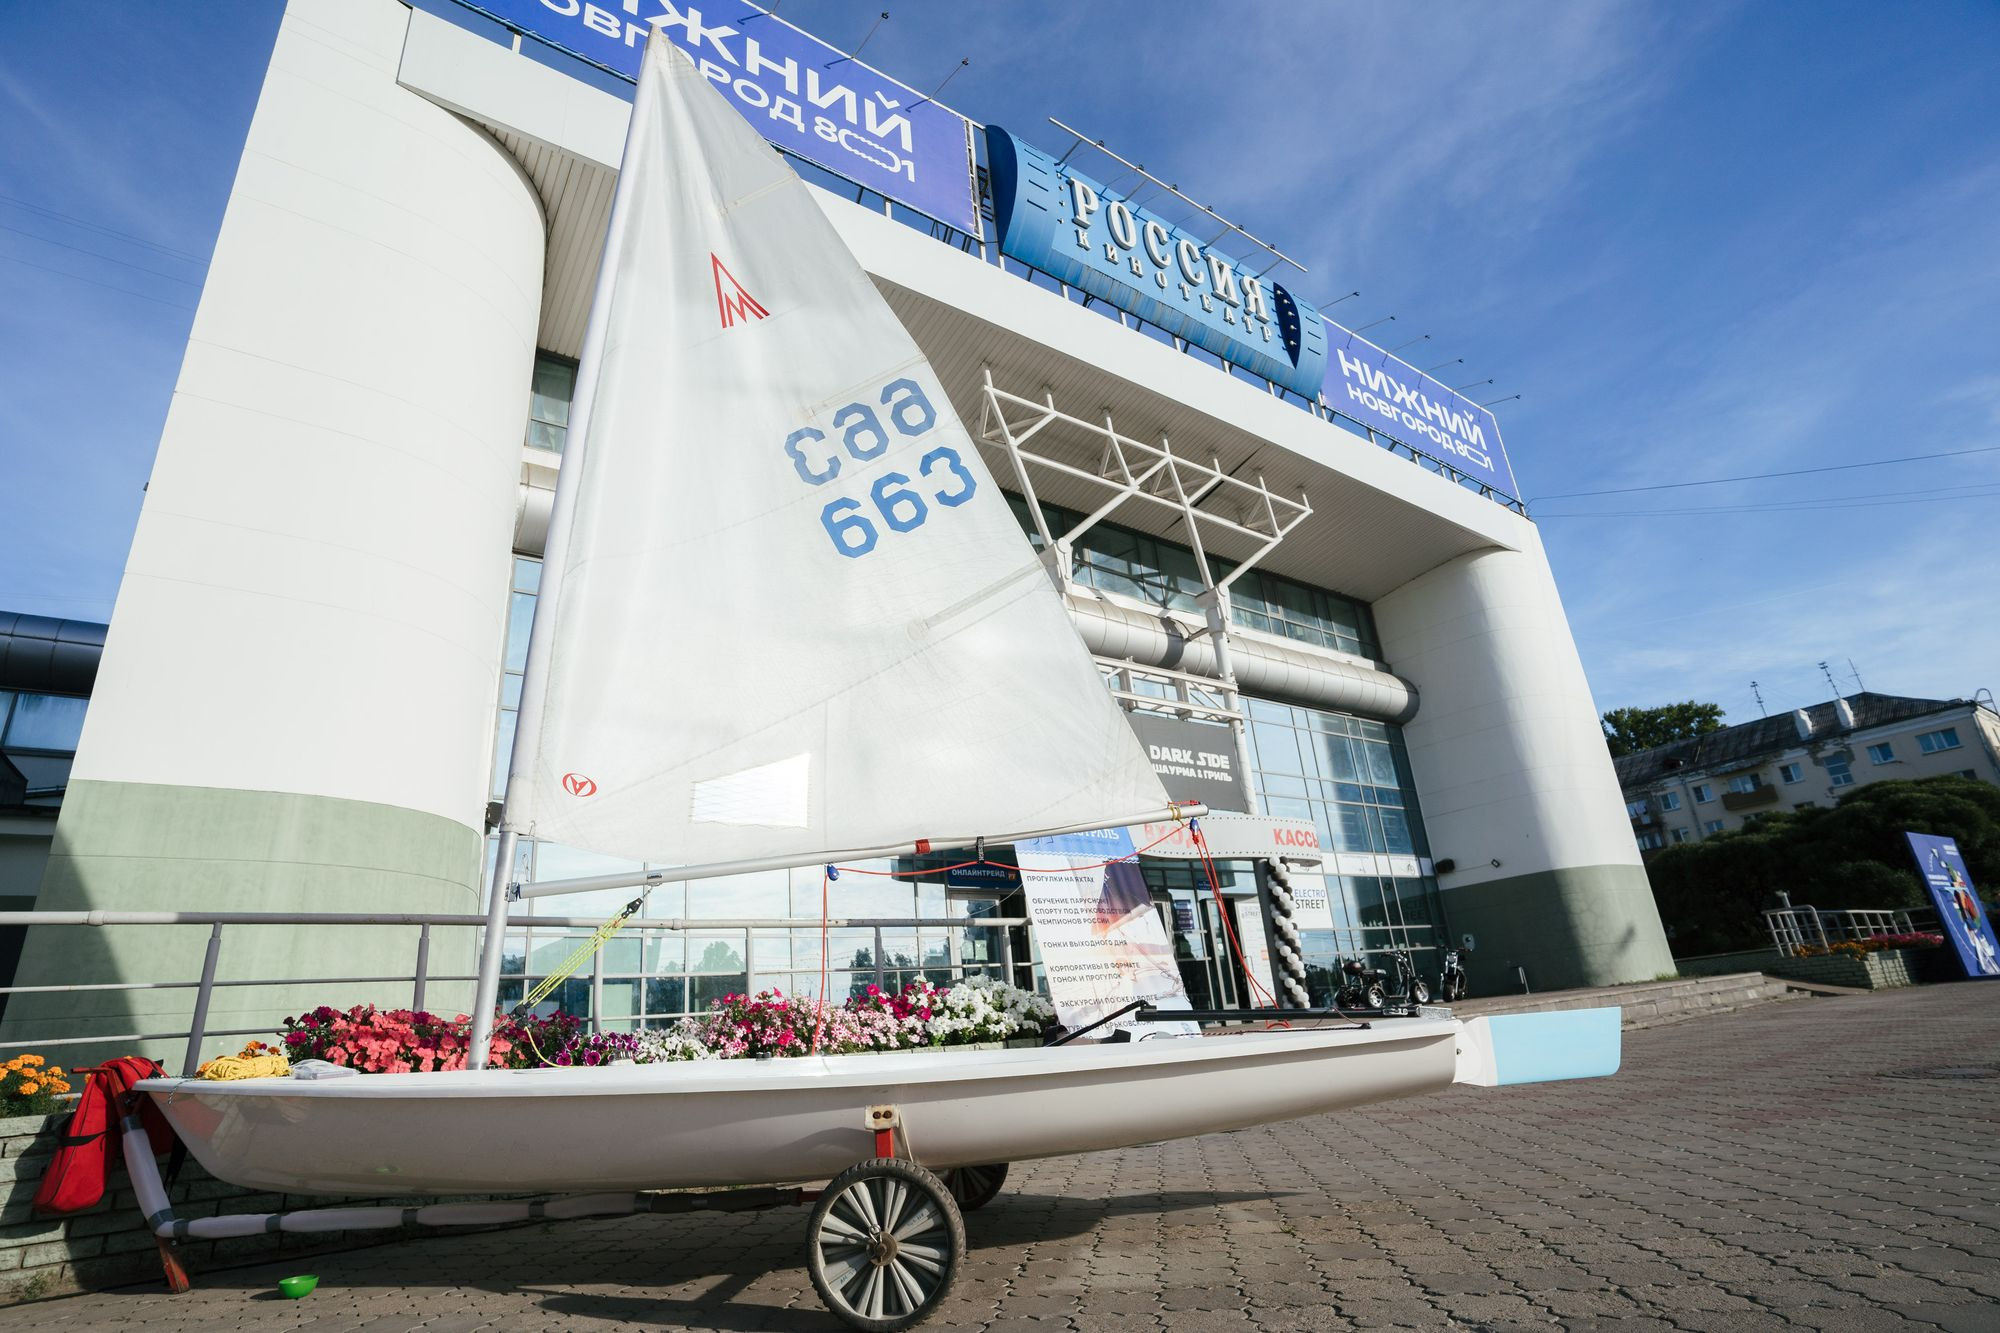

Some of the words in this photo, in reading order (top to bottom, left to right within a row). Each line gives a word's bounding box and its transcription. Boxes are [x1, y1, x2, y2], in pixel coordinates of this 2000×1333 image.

[1067, 177, 1271, 324] РОССИЯ
[1337, 348, 1488, 451] НИЖНИЙ
[1346, 382, 1457, 455] НОВГОРОД
[820, 446, 977, 558] 663
[1149, 745, 1195, 765] DARK
[1196, 752, 1230, 770] SIDE
[1152, 763, 1197, 778] ШАУРМА
[1203, 770, 1233, 782] ГРИЛЬ
[1026, 875, 1064, 883] ПРОГУЛКИ
[1294, 889, 1326, 898] ELECTRO
[1295, 899, 1325, 910] STREET
[1083, 917, 1110, 925] РОССИИ
[1069, 940, 1113, 948] ВЫХОДНОГО
[1050, 963, 1103, 972] КОРПОРАТИВЫ
[1053, 976, 1078, 984] ГОНОК
[1086, 973, 1122, 982] ПРОГУЛОК
[1060, 998, 1104, 1008] ЭКСКУРСИИ
